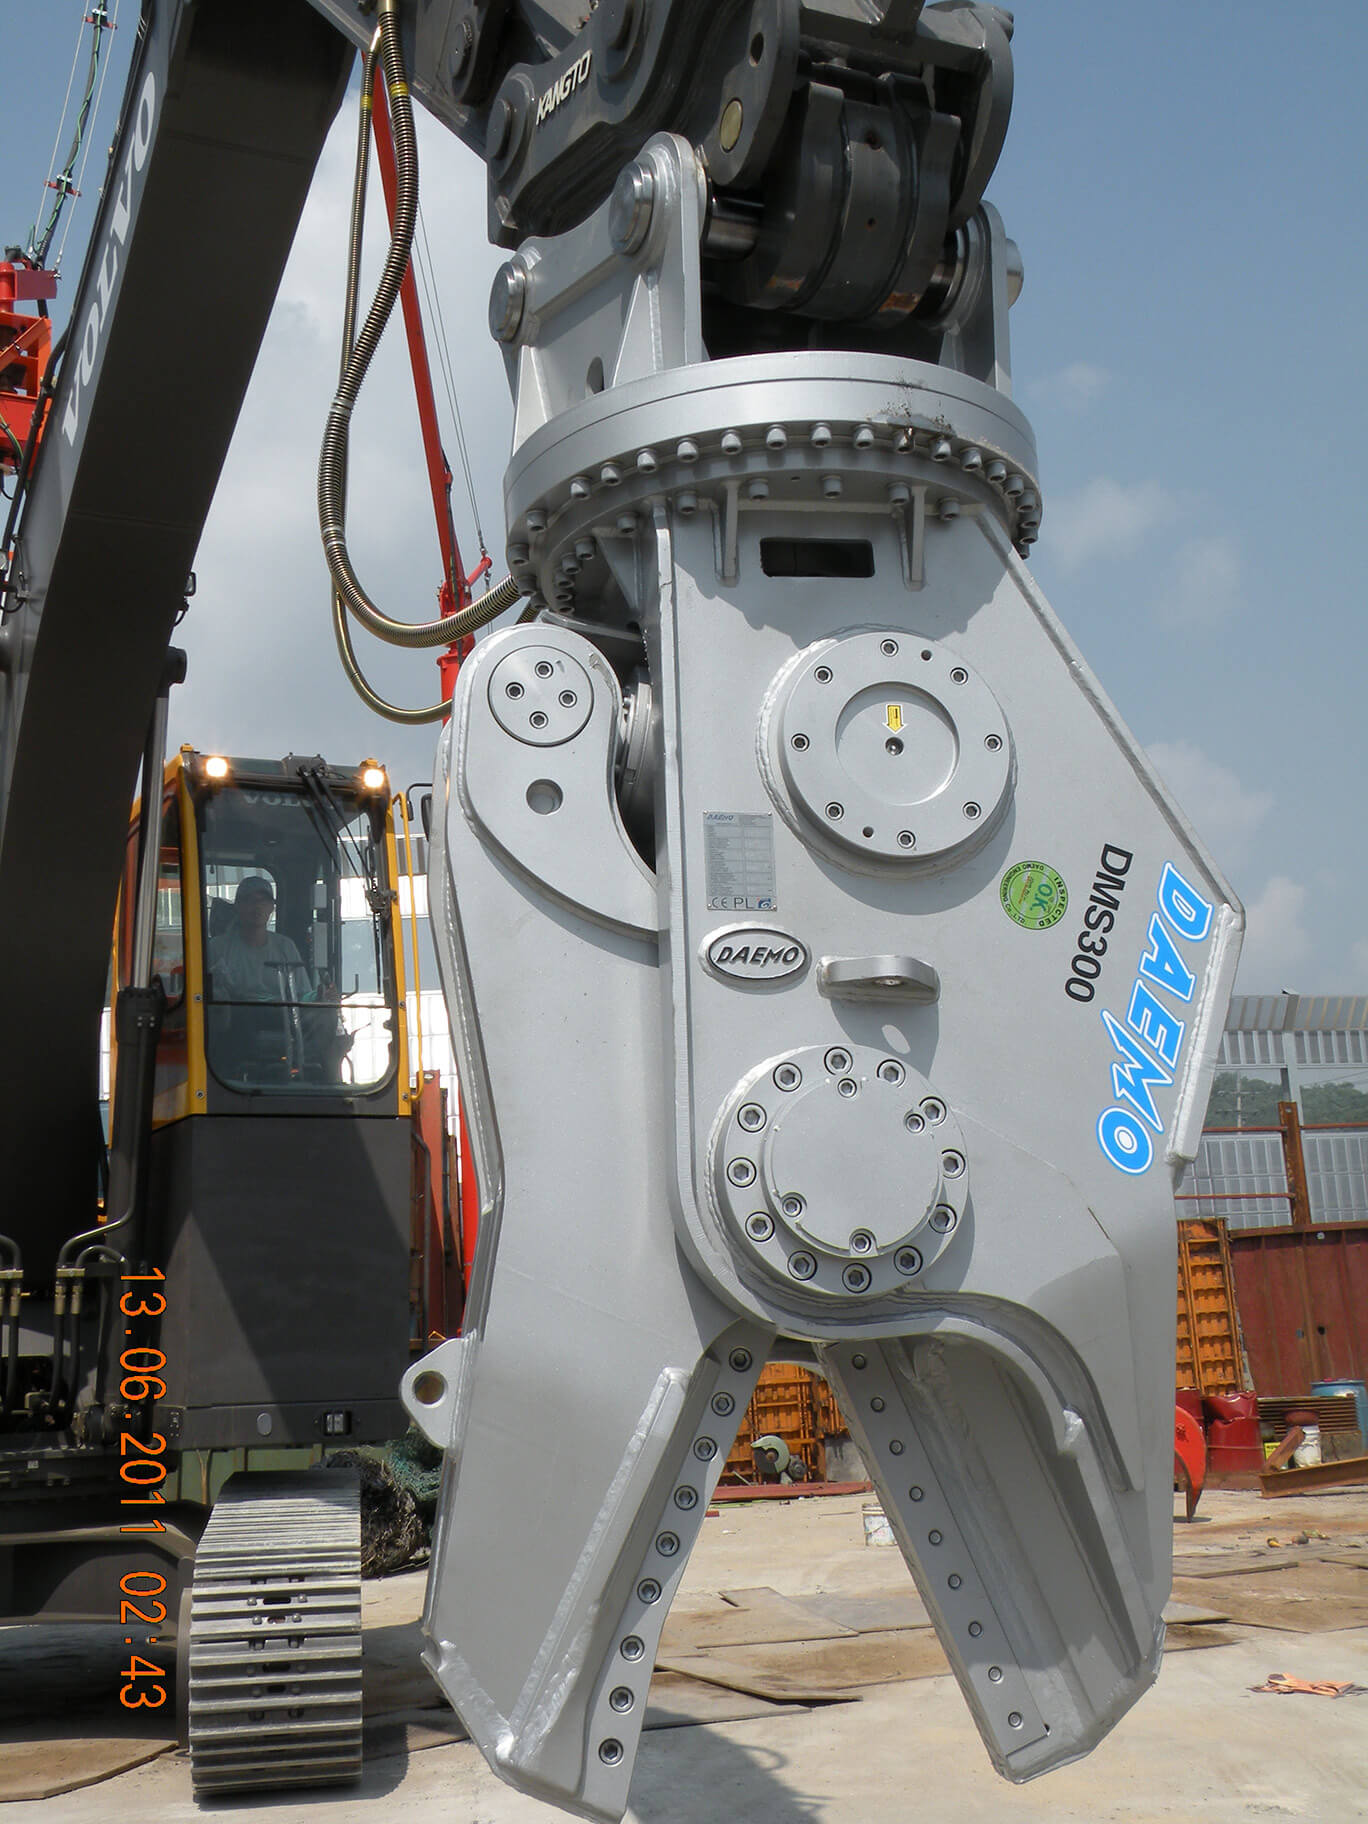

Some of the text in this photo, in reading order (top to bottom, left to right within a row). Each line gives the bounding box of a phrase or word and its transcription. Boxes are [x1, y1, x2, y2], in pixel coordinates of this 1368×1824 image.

[536, 49, 592, 126] KANGTO
[62, 72, 155, 447] VOLVO
[715, 946, 800, 967] DAEMO
[1038, 876, 1067, 927] INSPECTED
[1064, 843, 1133, 1003] DMS300
[1096, 862, 1214, 1175] DAEMO
